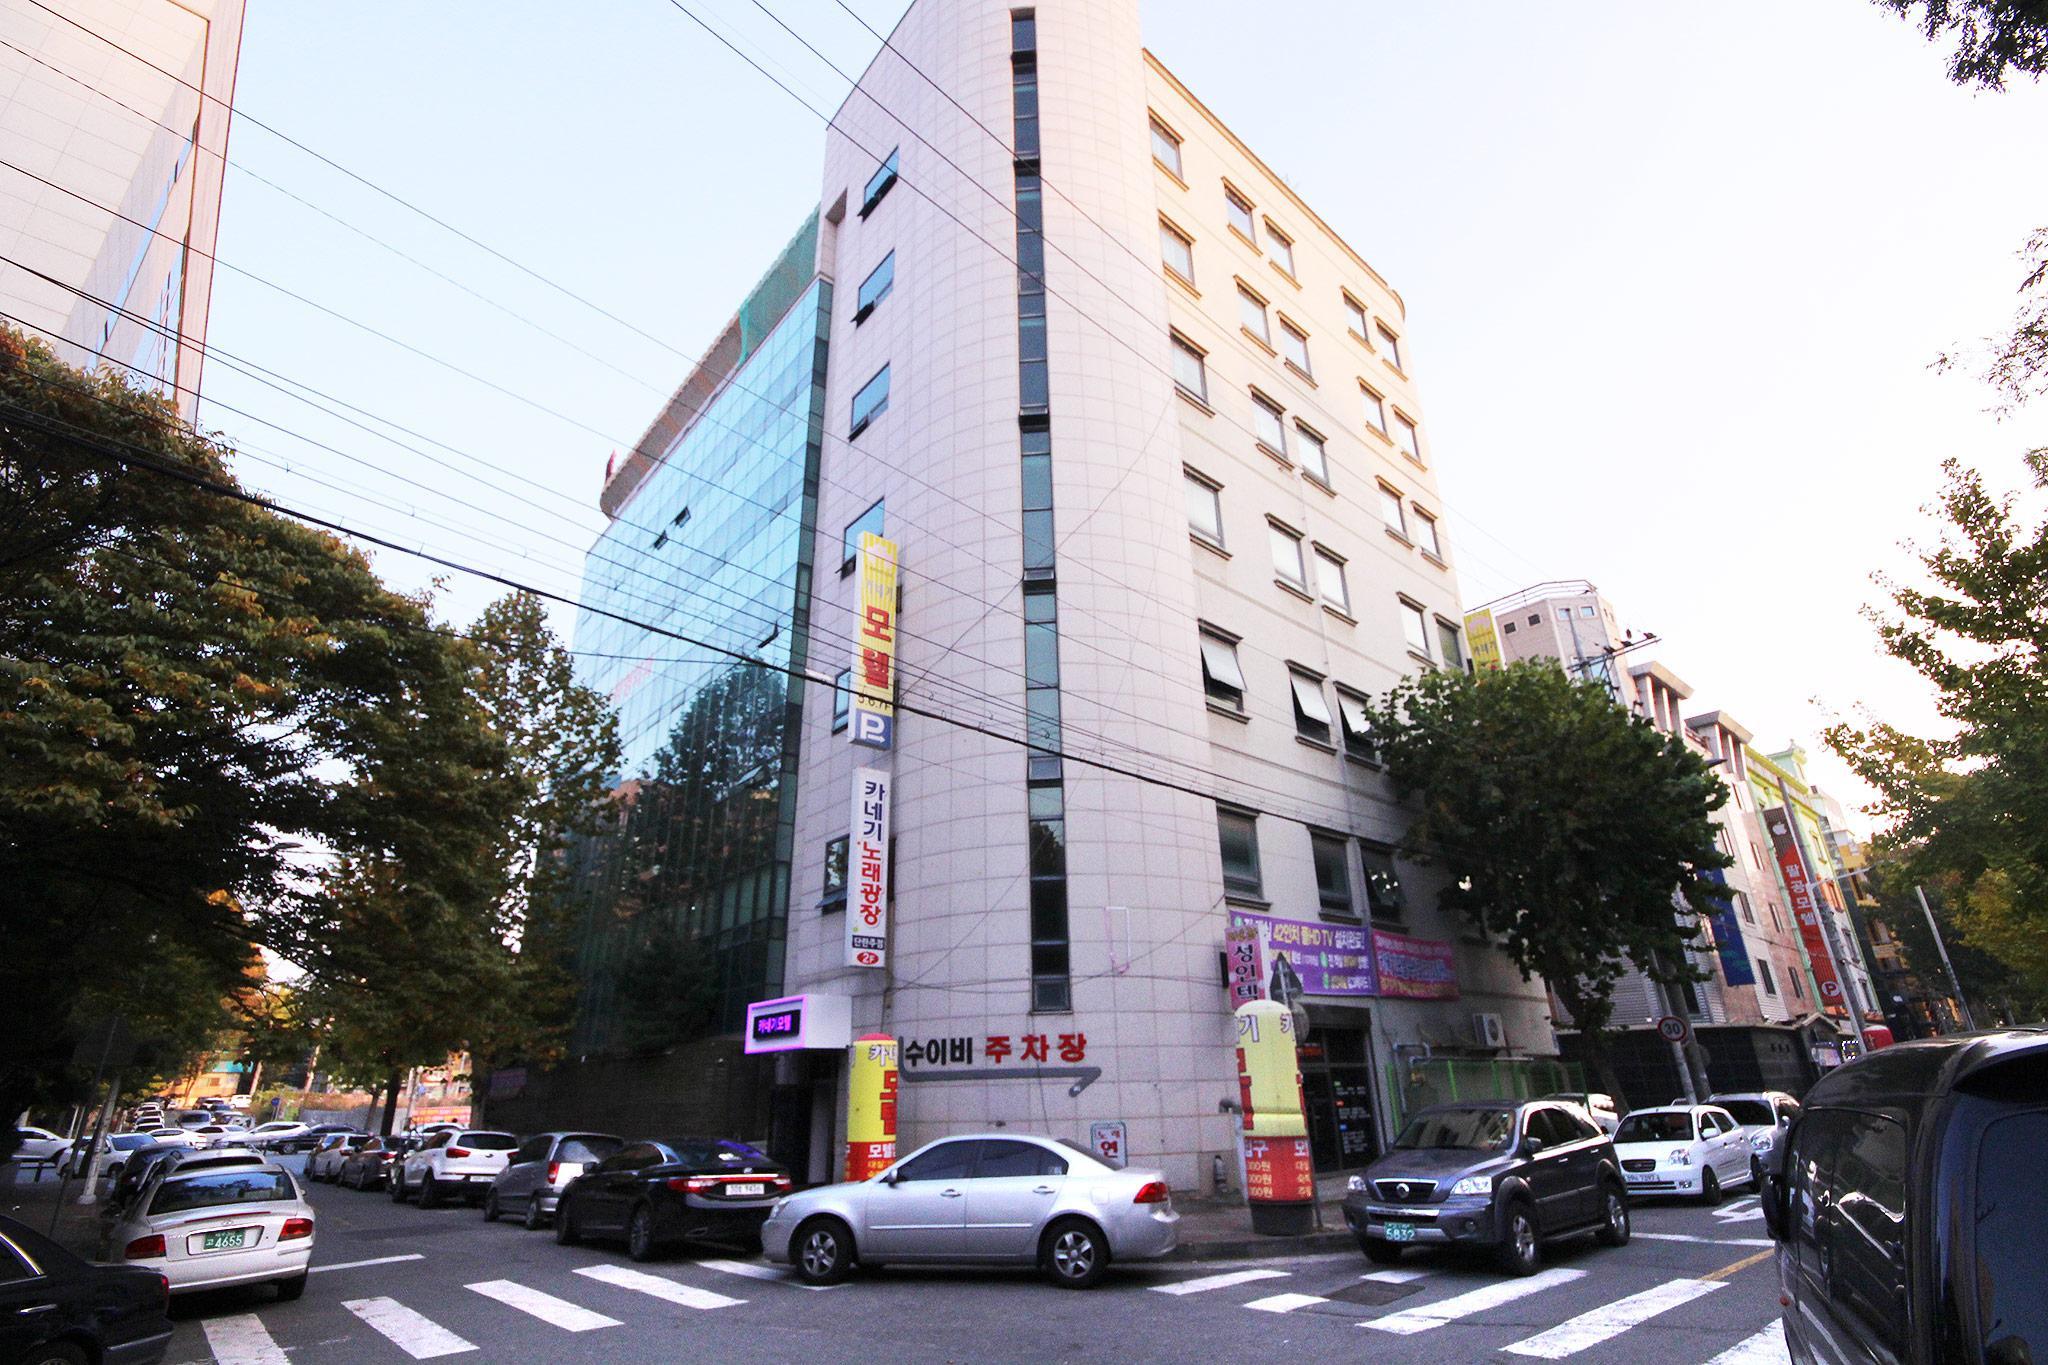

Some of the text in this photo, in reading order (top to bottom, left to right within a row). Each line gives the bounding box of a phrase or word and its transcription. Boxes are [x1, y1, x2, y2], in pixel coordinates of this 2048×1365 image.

[860, 711, 885, 740] P
[860, 780, 885, 926] 카네기 노래광장
[1664, 1022, 1681, 1035] 30
[905, 1037, 973, 1067] 수이비
[214, 1235, 242, 1247] 4655
